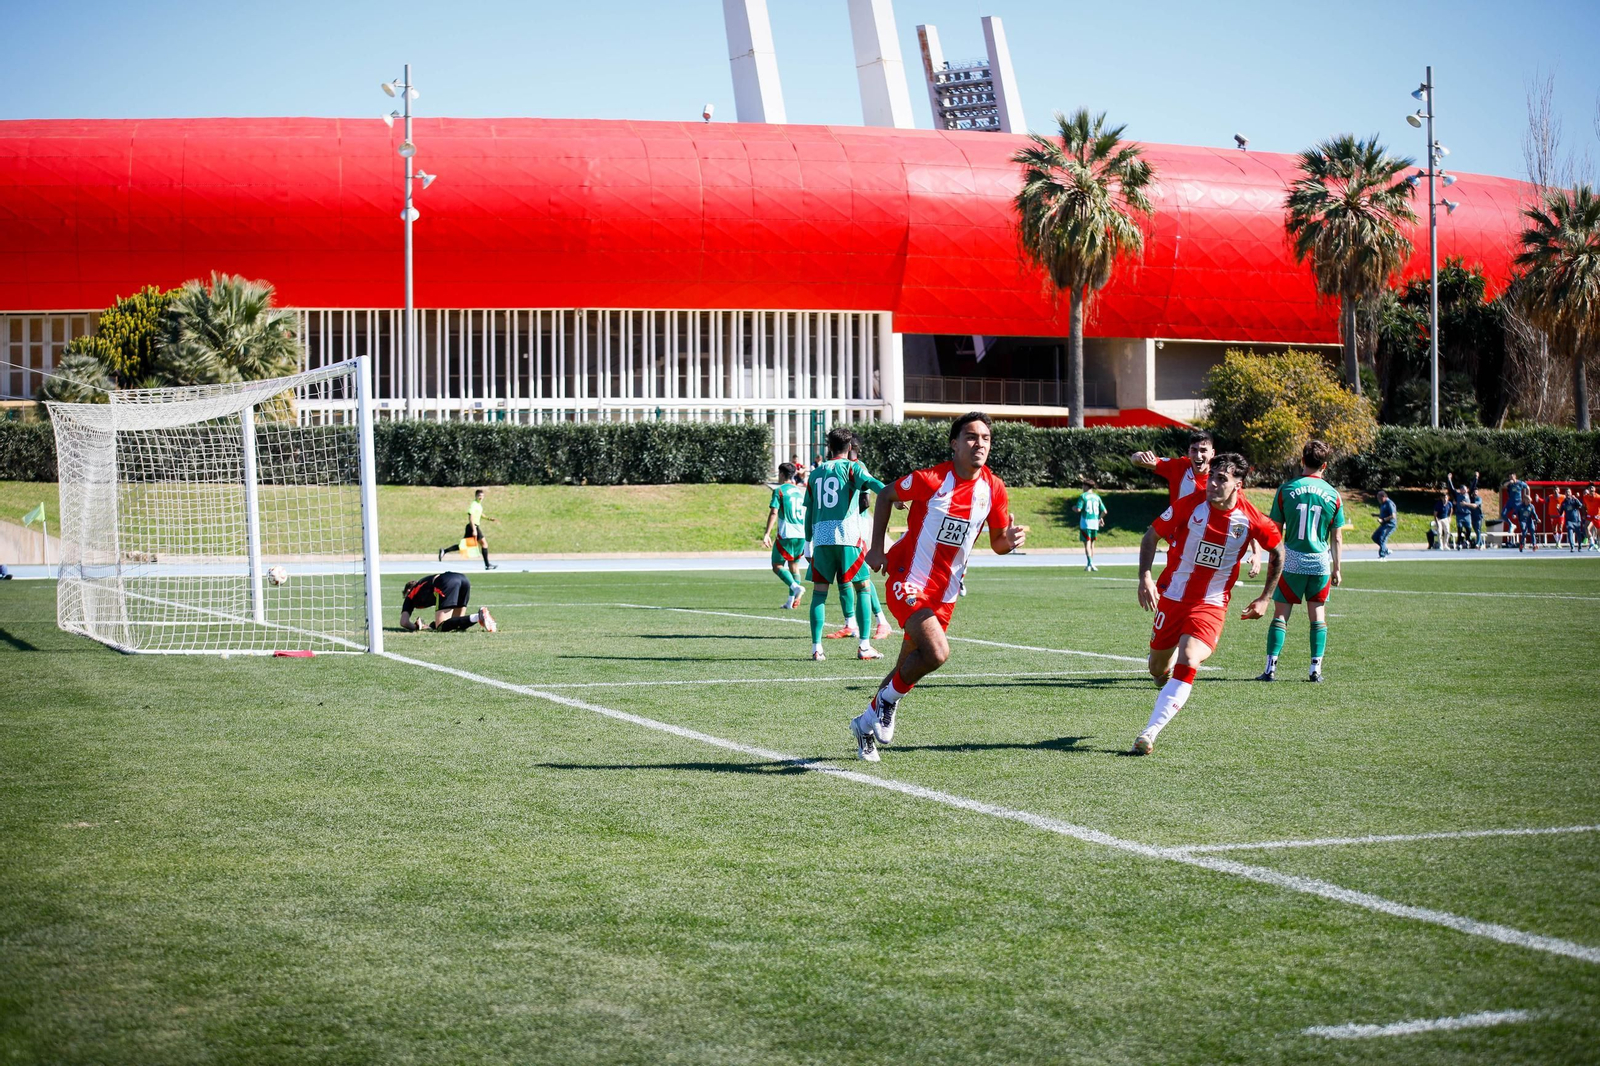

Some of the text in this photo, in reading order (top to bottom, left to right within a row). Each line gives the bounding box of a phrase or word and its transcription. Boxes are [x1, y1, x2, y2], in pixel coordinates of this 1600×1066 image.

[815, 477, 839, 509] 18
[1296, 503, 1322, 541] 11
[948, 523, 961, 532] DA
[944, 532, 959, 541] ZN
[1204, 547, 1217, 555] DA
[1202, 555, 1216, 563] ZN
